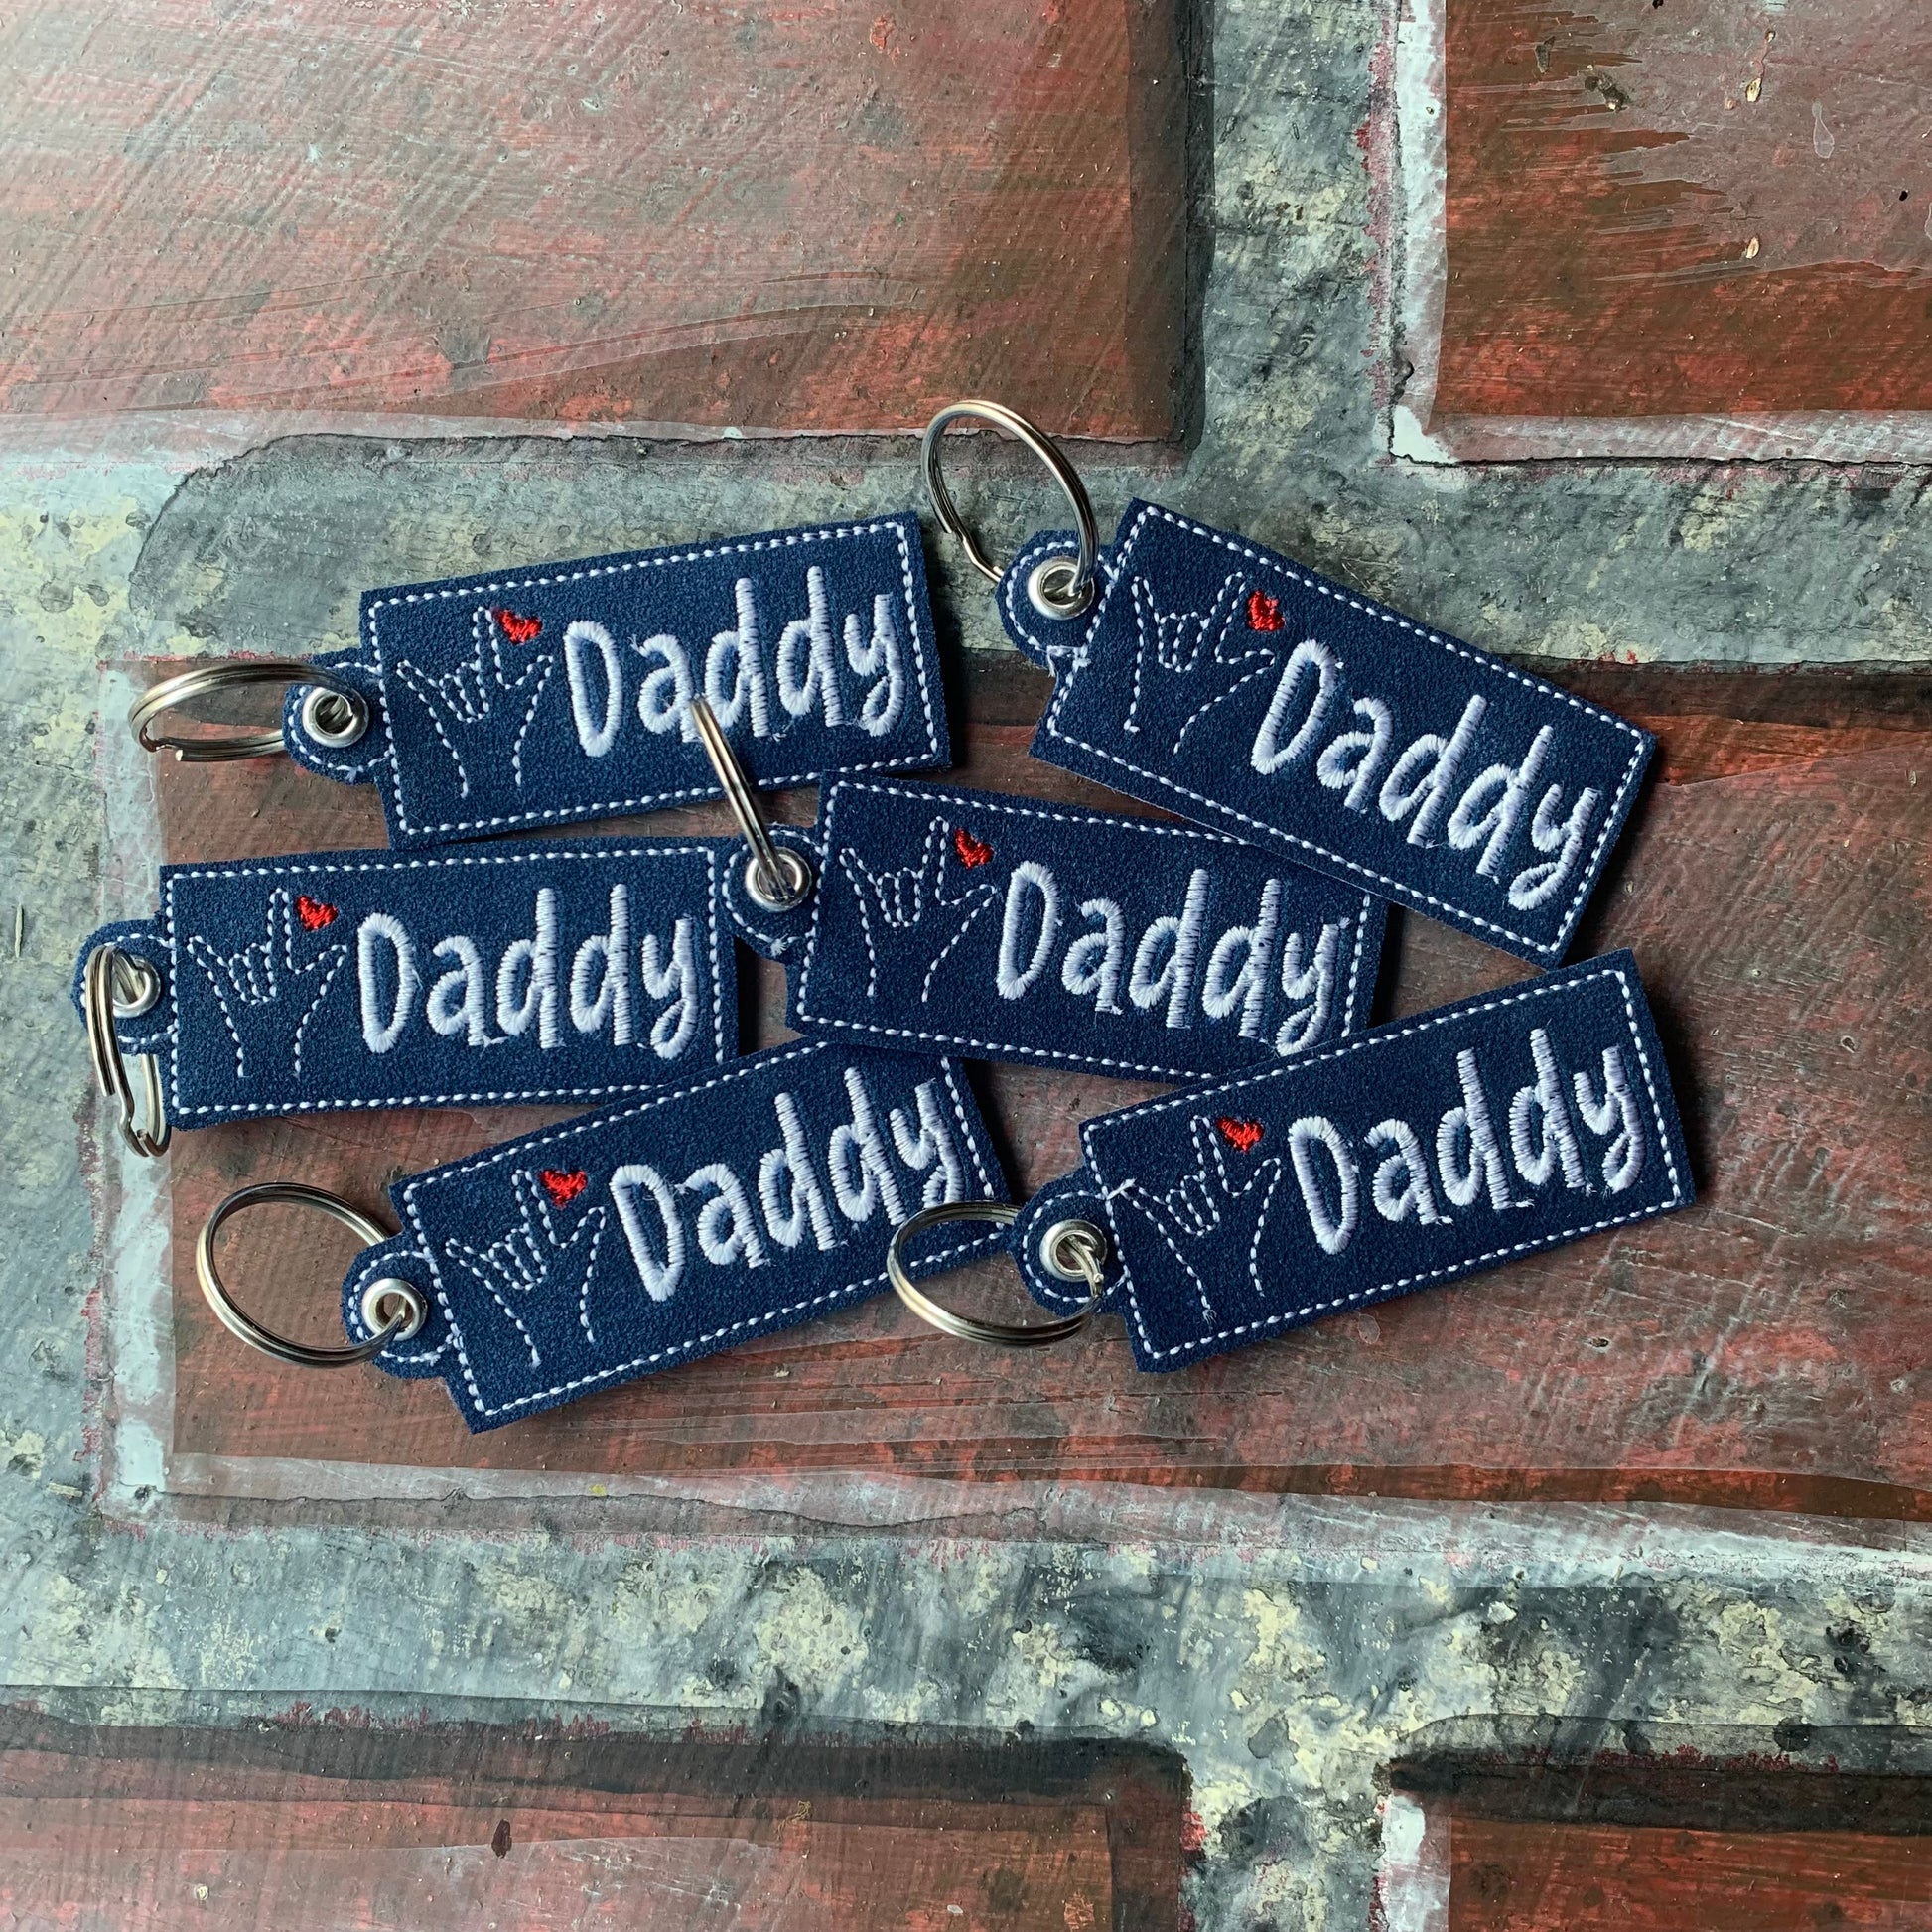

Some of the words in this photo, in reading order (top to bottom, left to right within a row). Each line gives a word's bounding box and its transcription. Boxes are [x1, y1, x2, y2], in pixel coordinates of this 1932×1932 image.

[564, 565, 904, 757] Daddy
[1251, 639, 1599, 910] Daddy
[358, 884, 695, 1059] Daddy
[997, 860, 1339, 1057] Daddy
[610, 1066, 965, 1301] Daddy
[1289, 1028, 1646, 1255] Daddy
